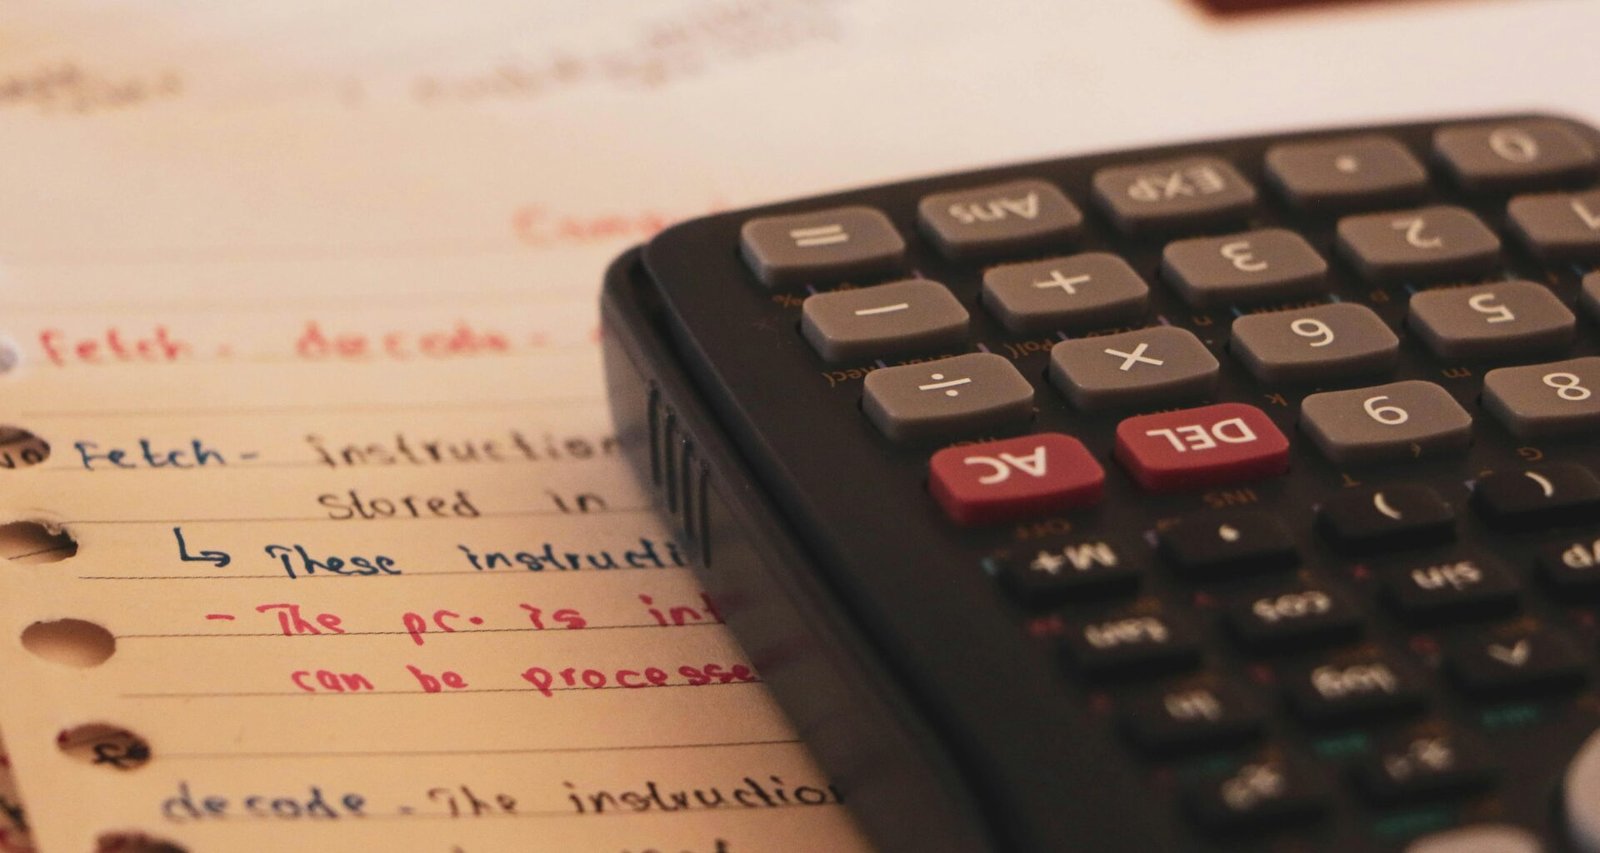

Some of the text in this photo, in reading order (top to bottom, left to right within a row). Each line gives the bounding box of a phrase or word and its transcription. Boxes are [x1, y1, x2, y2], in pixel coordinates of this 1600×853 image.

[1489, 128, 1538, 162] 0
[1127, 165, 1226, 200] EXP
[949, 191, 1040, 225] Ans
[1391, 217, 1443, 250] 2
[1219, 241, 1268, 273] 3
[1468, 292, 1516, 324] 5
[1290, 318, 1335, 348] 6
[1542, 372, 1592, 401] 8
[1363, 395, 1409, 426] 9
[1145, 417, 1258, 452] DEL
[963, 445, 1047, 484] AC
[264, 543, 403, 580] These
[1030, 541, 1119, 576] M+
[255, 603, 346, 636] The
[519, 603, 587, 630] is
[291, 669, 375, 693] can
[406, 664, 469, 693] be
[161, 780, 367, 823] decode
[428, 785, 517, 819] The
